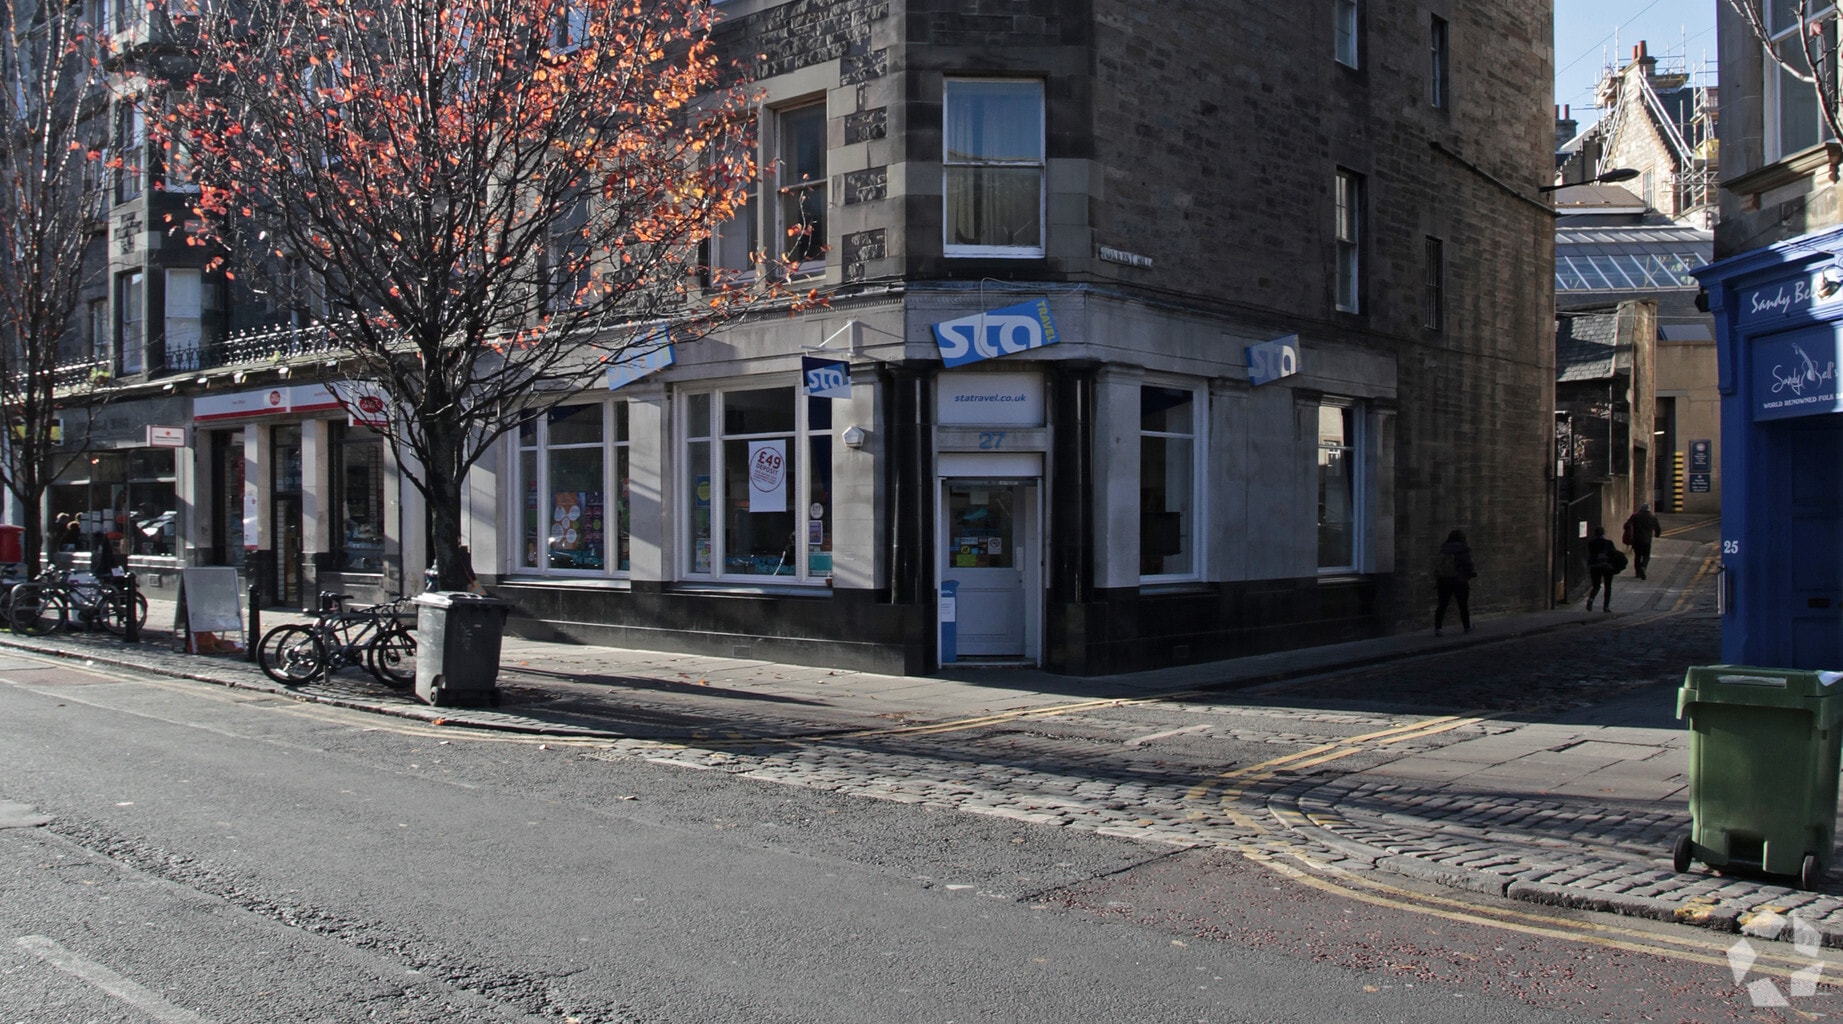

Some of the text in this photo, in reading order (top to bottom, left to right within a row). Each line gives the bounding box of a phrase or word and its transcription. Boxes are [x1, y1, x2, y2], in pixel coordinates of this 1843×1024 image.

[1751, 287, 1791, 314] Sandy
[1036, 300, 1056, 342] TRAVEL
[938, 312, 1042, 358] sta
[1248, 340, 1297, 379] sta
[807, 367, 844, 389] sta
[1771, 364, 1802, 395] Sandy
[954, 394, 1027, 403] statravel.co.uk
[1763, 401, 1783, 409] WORLD
[1784, 396, 1818, 406] RENOWNED
[1818, 393, 1835, 402] FOLK
[979, 431, 1007, 449] 27
[755, 462, 779, 476] DEPOSIT
[757, 451, 781, 470] £49
[1723, 539, 1739, 554] 25
